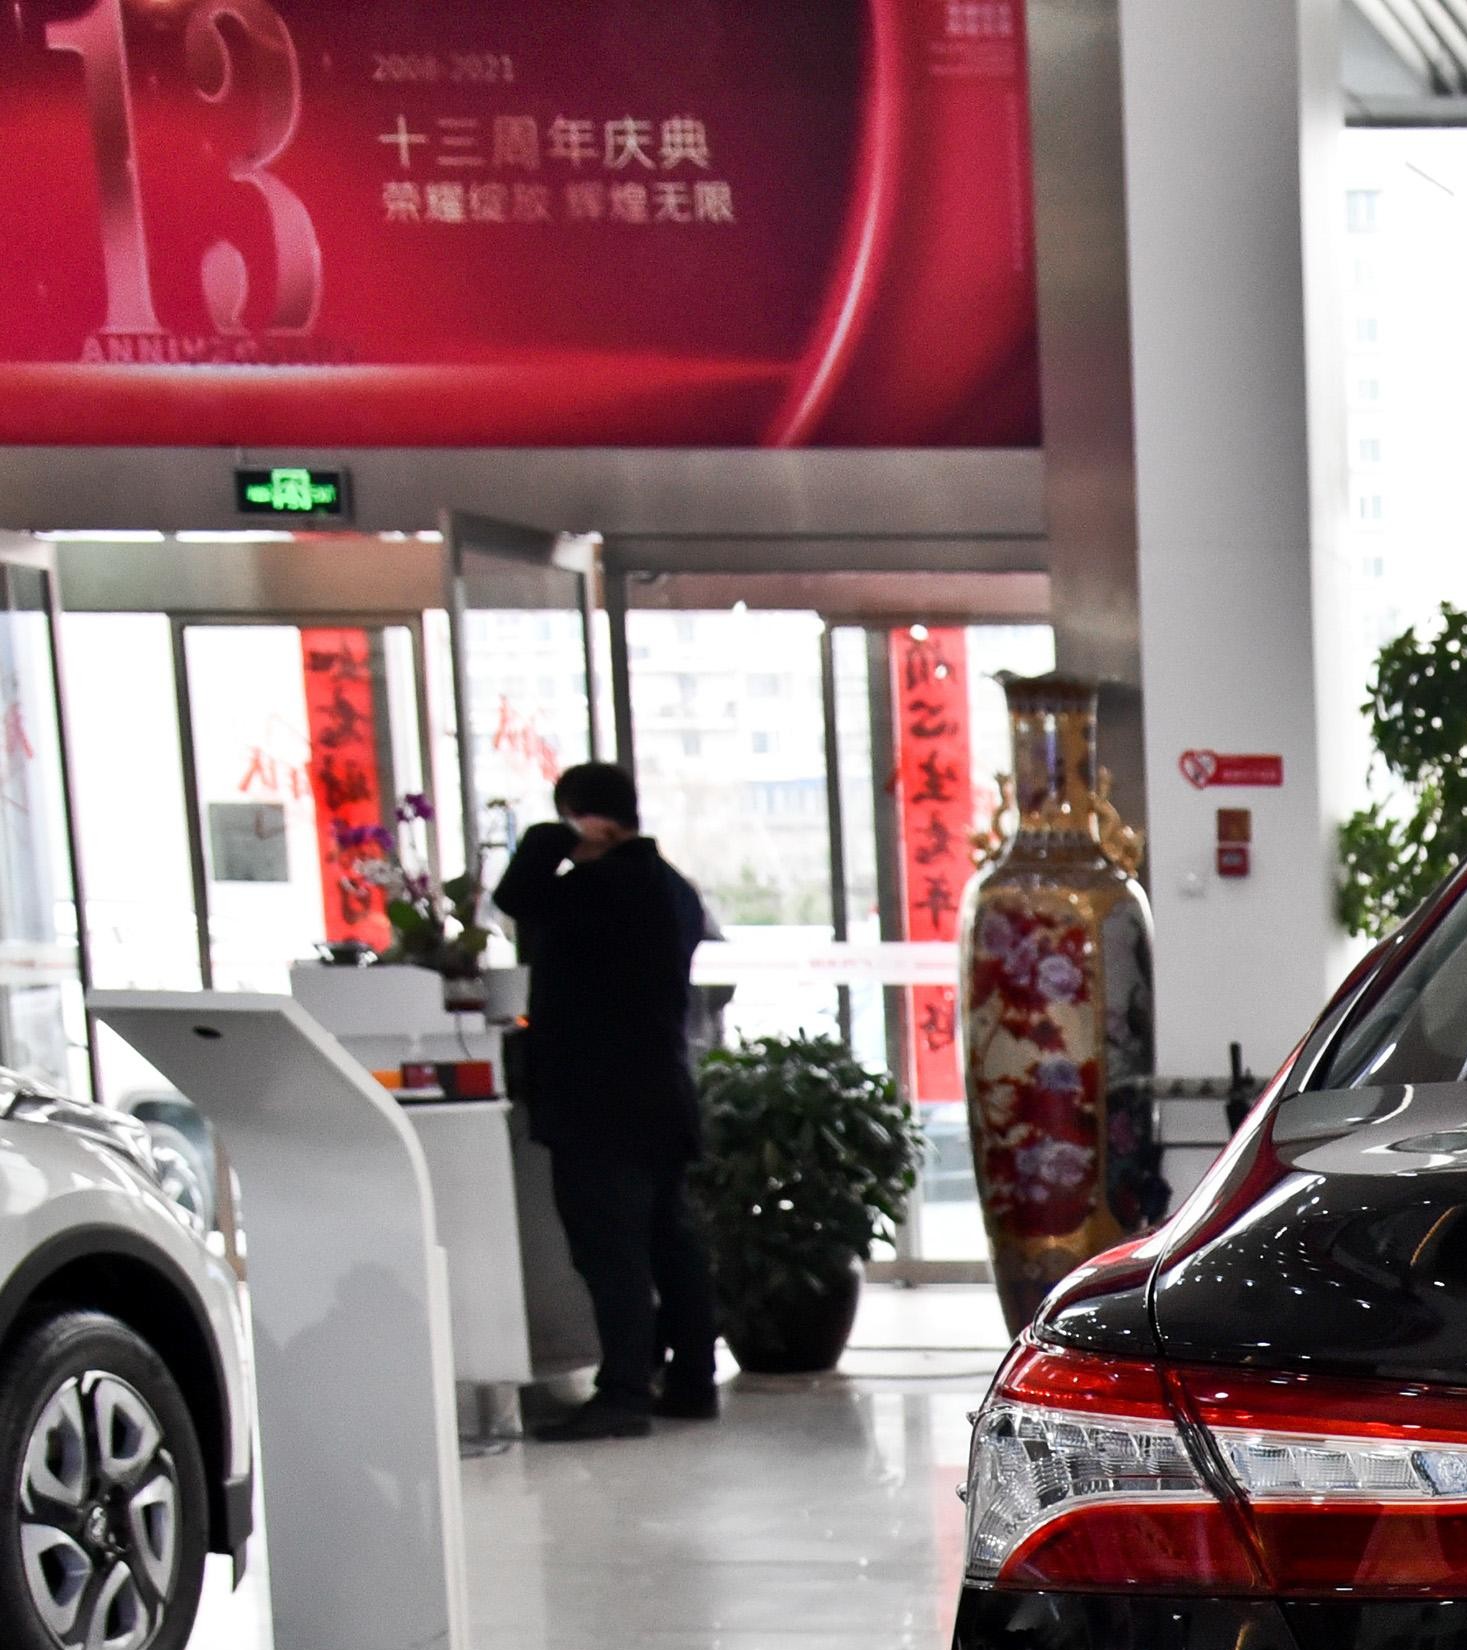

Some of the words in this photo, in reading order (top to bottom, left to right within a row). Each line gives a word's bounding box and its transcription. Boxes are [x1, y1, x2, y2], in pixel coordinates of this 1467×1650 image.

[45, 0, 323, 337] 13
[377, 114, 711, 169] 十三周年庆典
